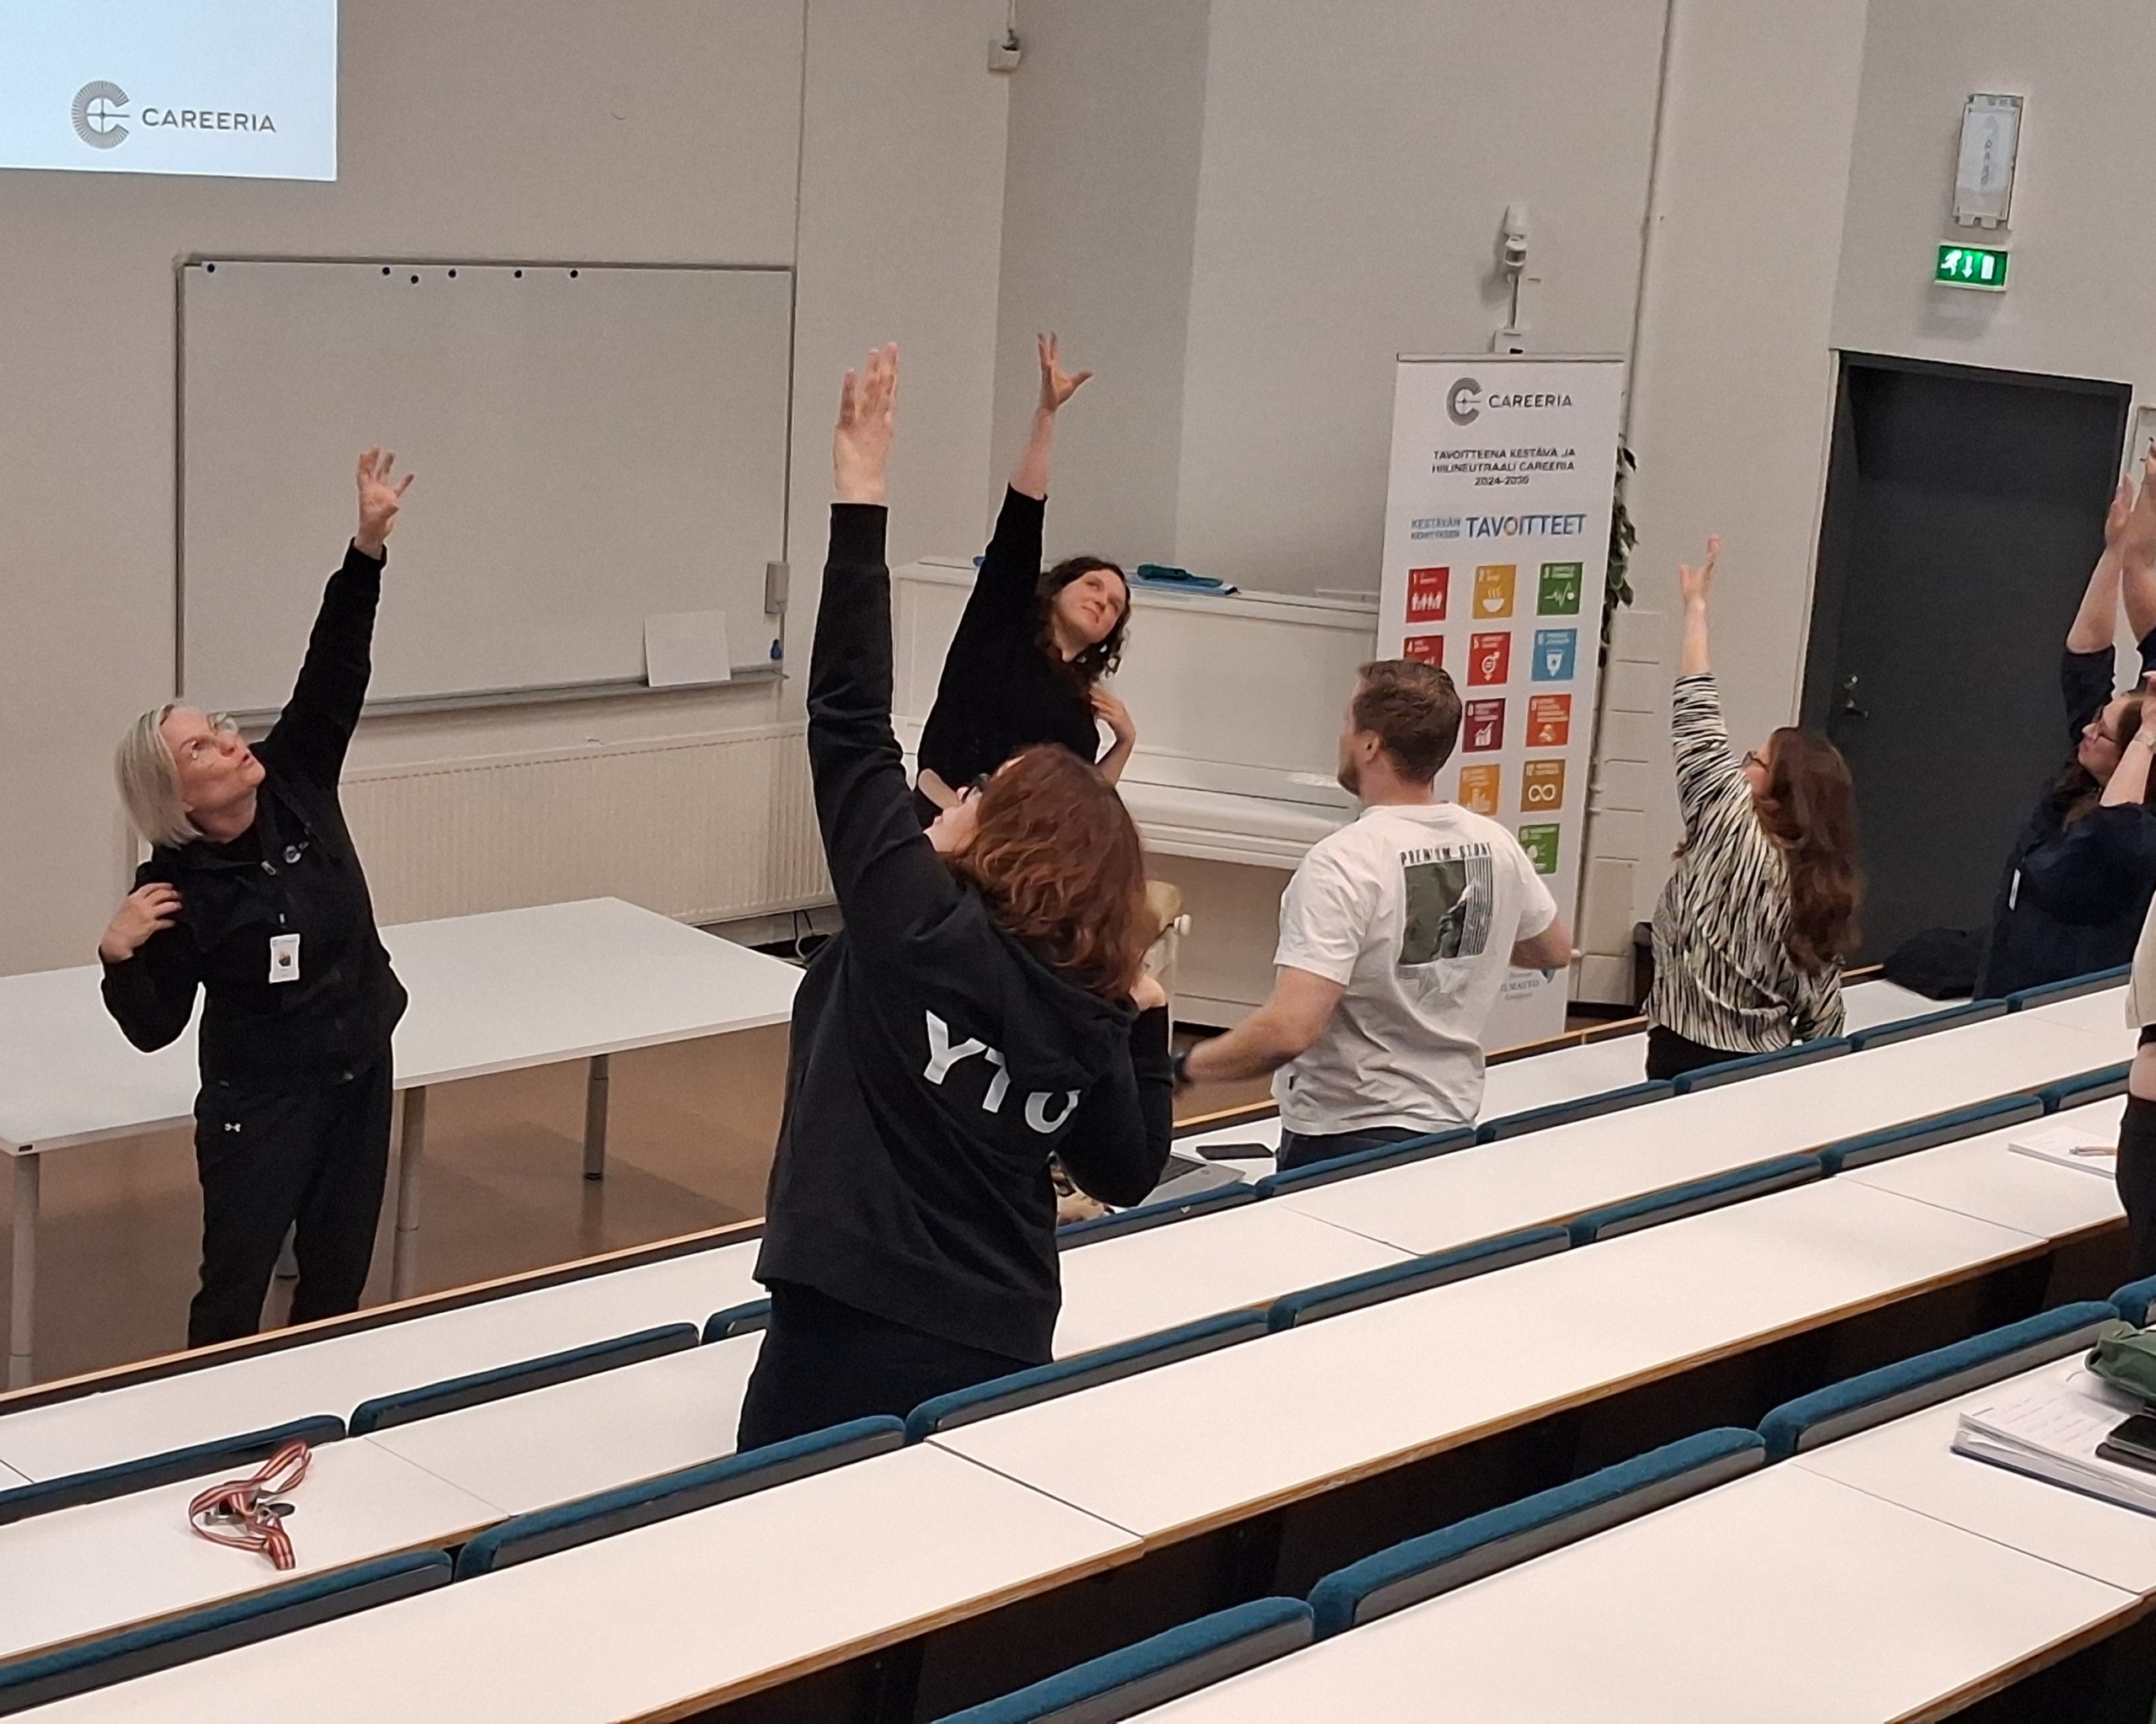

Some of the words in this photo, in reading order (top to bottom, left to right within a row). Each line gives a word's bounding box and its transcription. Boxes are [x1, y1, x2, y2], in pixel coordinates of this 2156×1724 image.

[141, 107, 277, 133] CAREERIA
[1488, 394, 1573, 408] CAREERIA
[1433, 449, 1507, 461] TAVOITTEENA
[1509, 447, 1558, 459] KESTÄVÄ
[1561, 448, 1576, 458] JA
[1518, 461, 1575, 472] CAREERIA
[1465, 513, 1588, 538] TAVOITTEET
